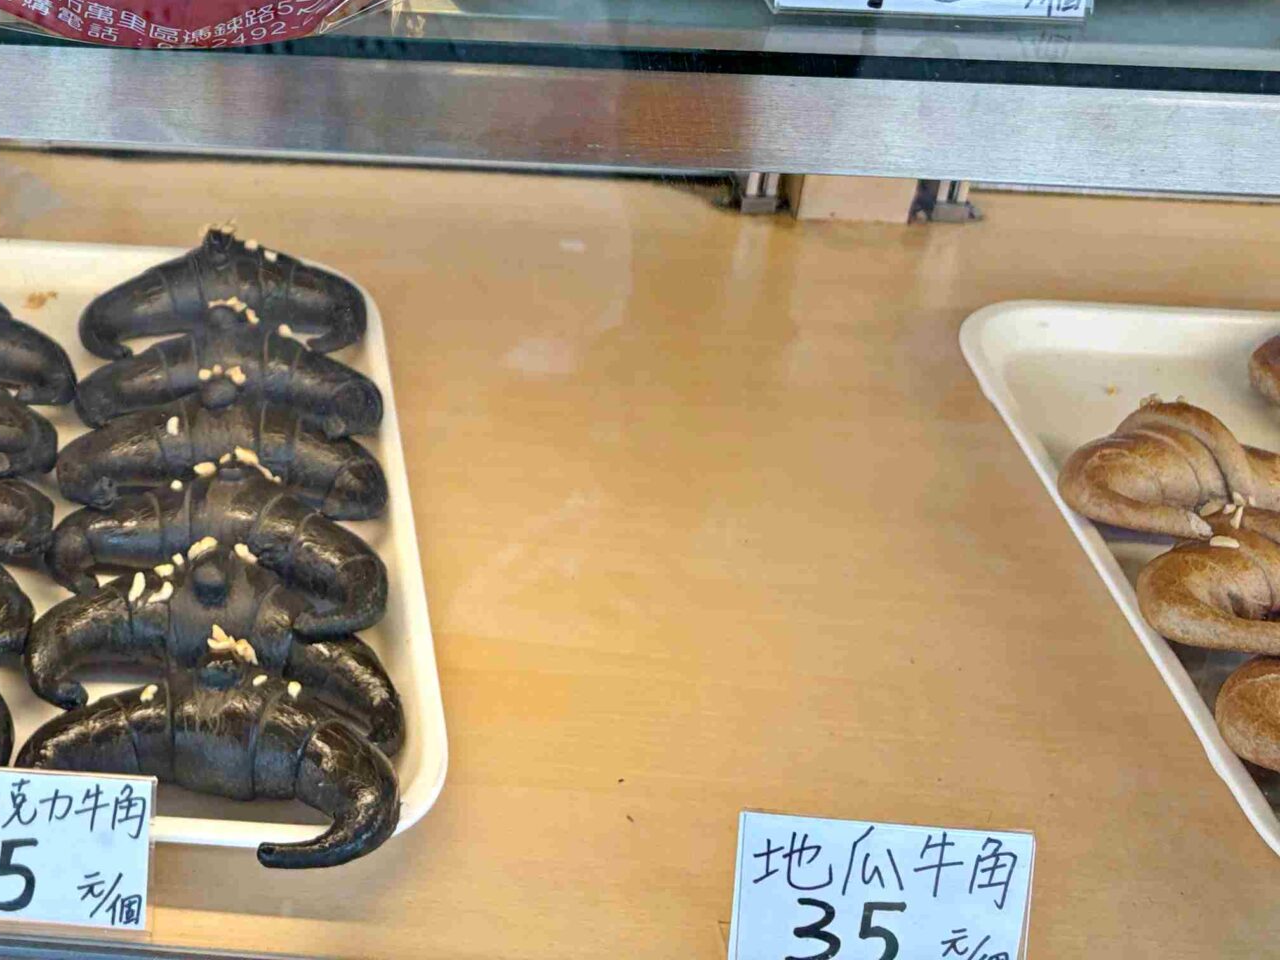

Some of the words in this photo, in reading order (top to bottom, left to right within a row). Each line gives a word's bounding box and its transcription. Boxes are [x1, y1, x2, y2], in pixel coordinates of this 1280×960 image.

[753, 826, 1018, 910] 地瓜牛角
[784, 897, 908, 960] 35
